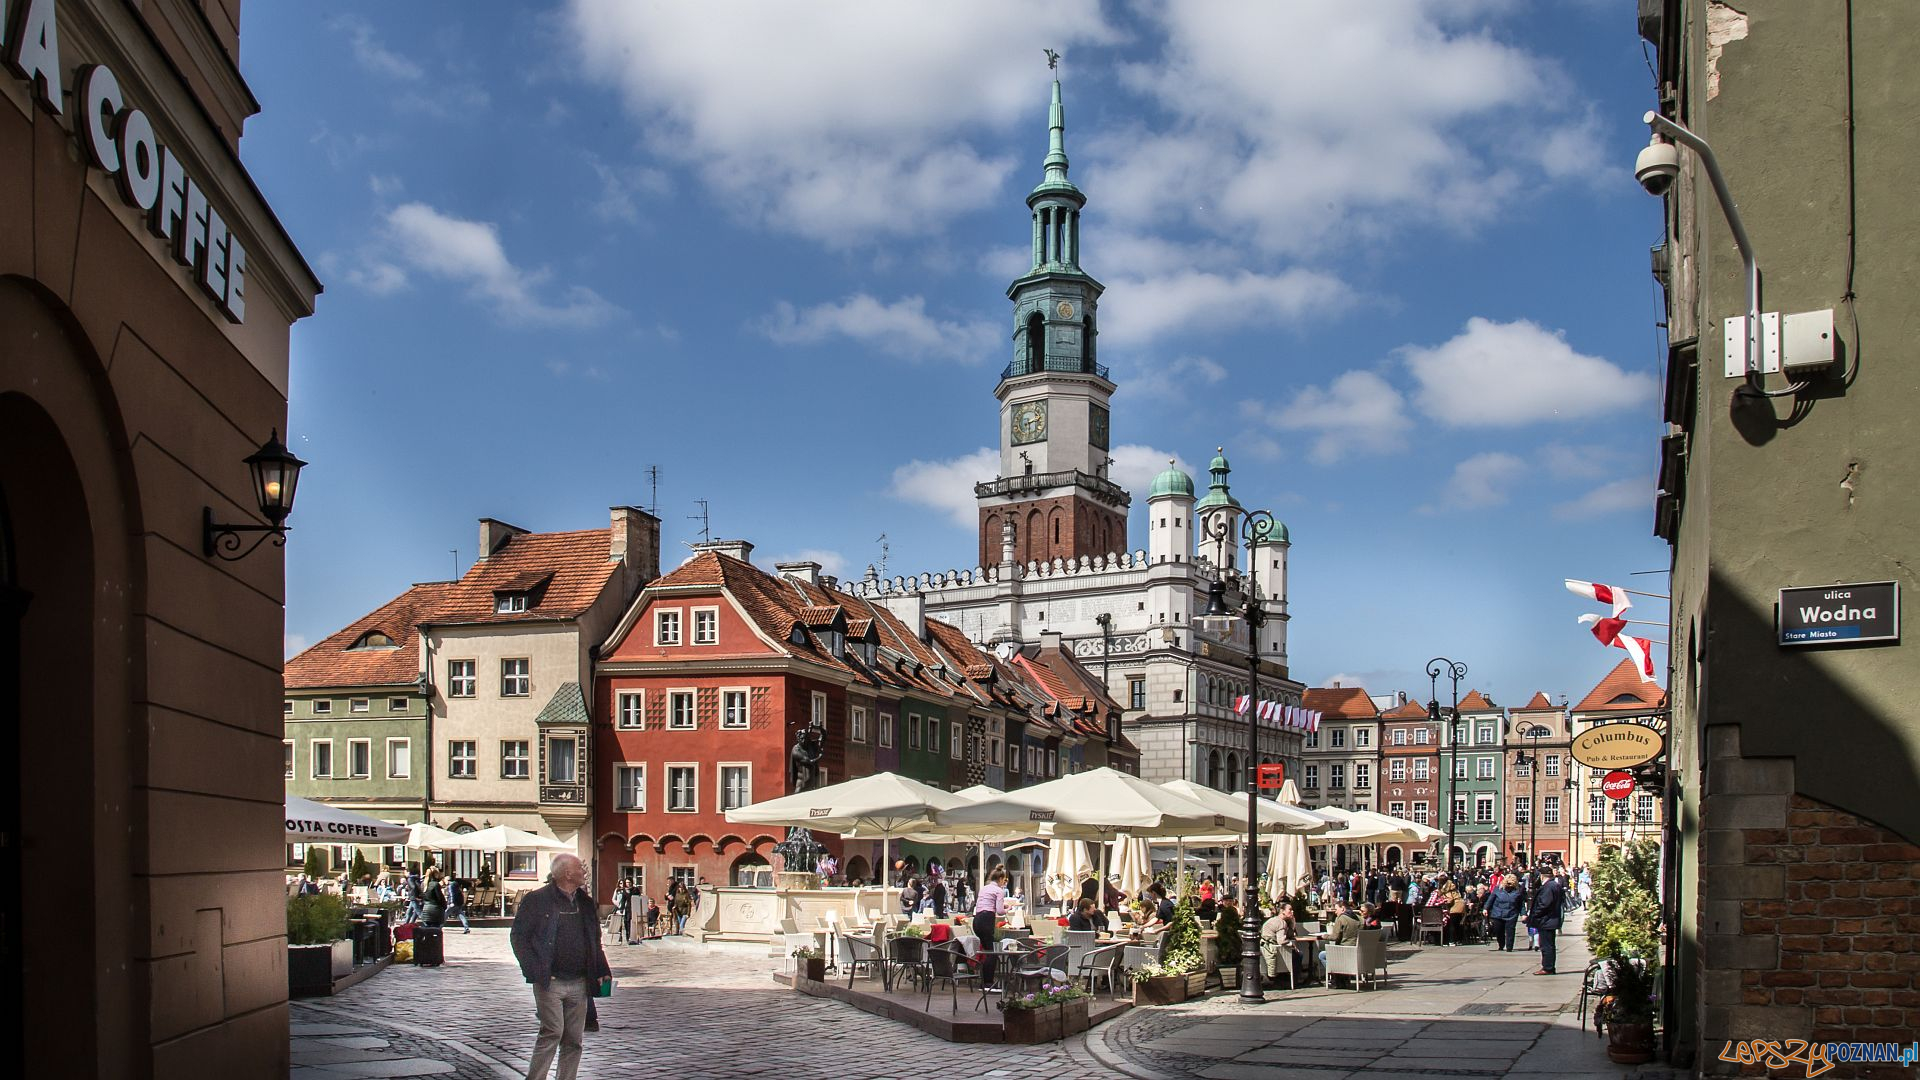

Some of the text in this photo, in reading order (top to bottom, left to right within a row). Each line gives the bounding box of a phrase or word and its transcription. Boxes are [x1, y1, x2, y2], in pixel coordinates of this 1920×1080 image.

[0, 0, 246, 325] A COFFEE
[1824, 590, 1851, 600] ulica
[1800, 604, 1876, 623] Wodna
[1809, 630, 1837, 638] Miasto
[1581, 730, 1650, 750] Columbus
[1603, 779, 1632, 791] Coca-Cola
[1031, 811, 1053, 819] TYSKIE
[328, 822, 378, 837] COFFEE
